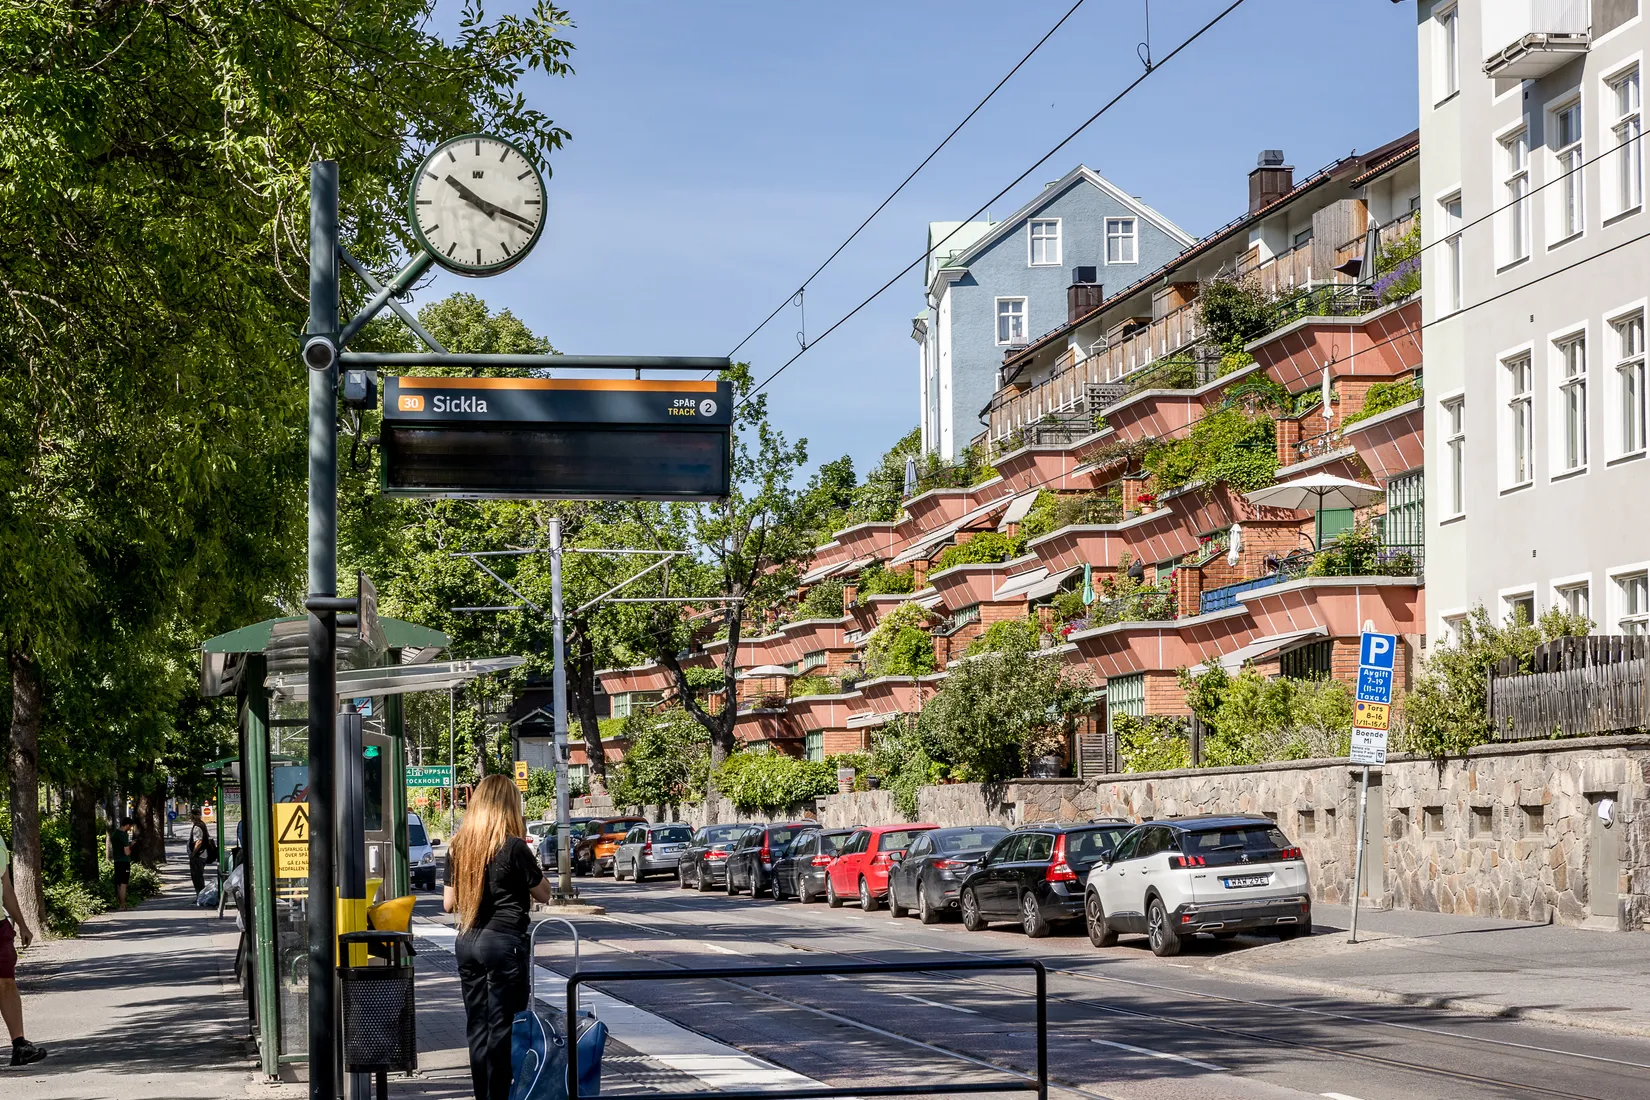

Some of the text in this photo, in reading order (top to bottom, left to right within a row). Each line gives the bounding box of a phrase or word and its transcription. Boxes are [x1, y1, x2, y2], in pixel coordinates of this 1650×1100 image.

[404, 395, 488, 412] 30 Sickla
[673, 398, 696, 408] SPÅR
[704, 402, 712, 413] 2
[668, 408, 696, 416] TRACK
[1368, 636, 1390, 664] P
[1363, 669, 1388, 678] Avgift
[1367, 677, 1384, 686] 7-19
[1363, 685, 1386, 694] (11-17)
[1360, 692, 1380, 701] Taxa
[1366, 712, 1383, 720] 8-16
[1356, 719, 1386, 728] 1/11-15/5
[1356, 730, 1384, 738] Boende
